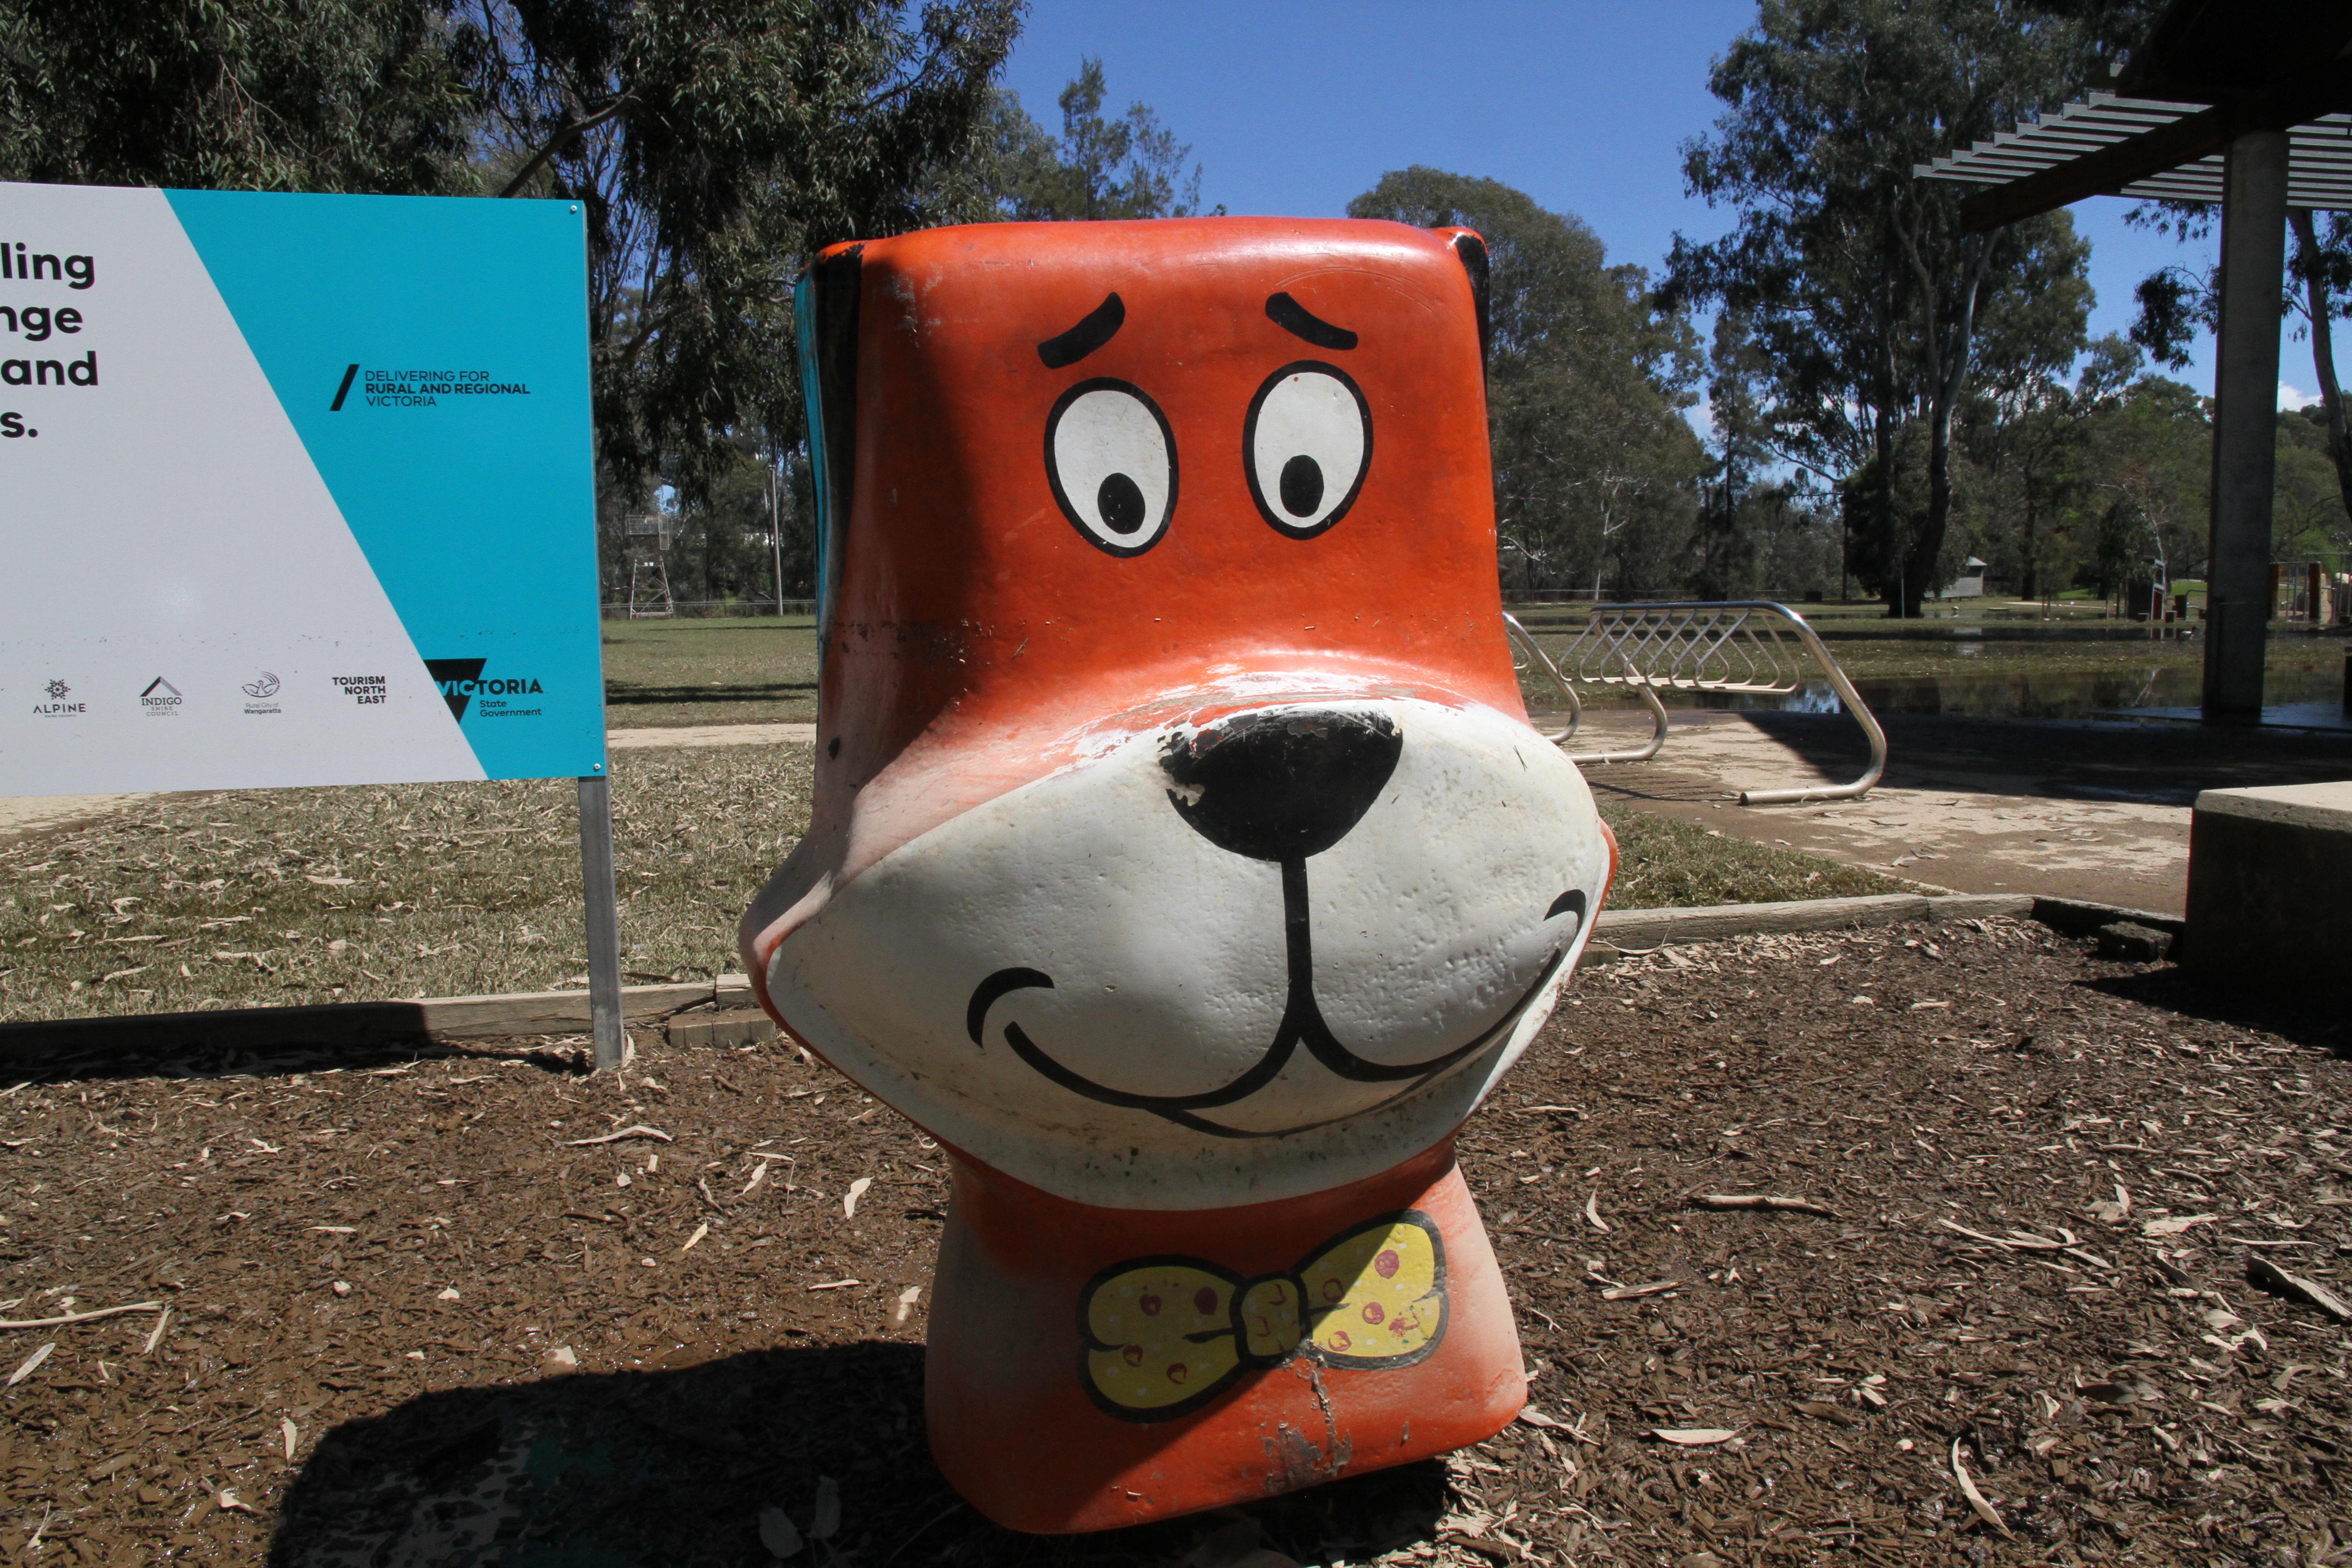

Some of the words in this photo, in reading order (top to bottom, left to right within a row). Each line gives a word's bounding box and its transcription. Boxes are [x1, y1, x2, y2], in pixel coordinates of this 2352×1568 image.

[1, 350, 98, 386] and
[365, 371, 455, 382] DELIVERING
[460, 371, 489, 382] FOR
[366, 383, 415, 394] RURAL
[420, 383, 452, 394] AND
[454, 383, 530, 394] REGIONAL
[366, 396, 437, 406] VICTORIA
[332, 676, 385, 685] TOURISM
[345, 686, 386, 694] NORTH
[142, 697, 182, 705] INDIGO
[358, 695, 387, 704] EAST
[33, 703, 86, 713] ALPINE
[480, 708, 542, 717] Government
